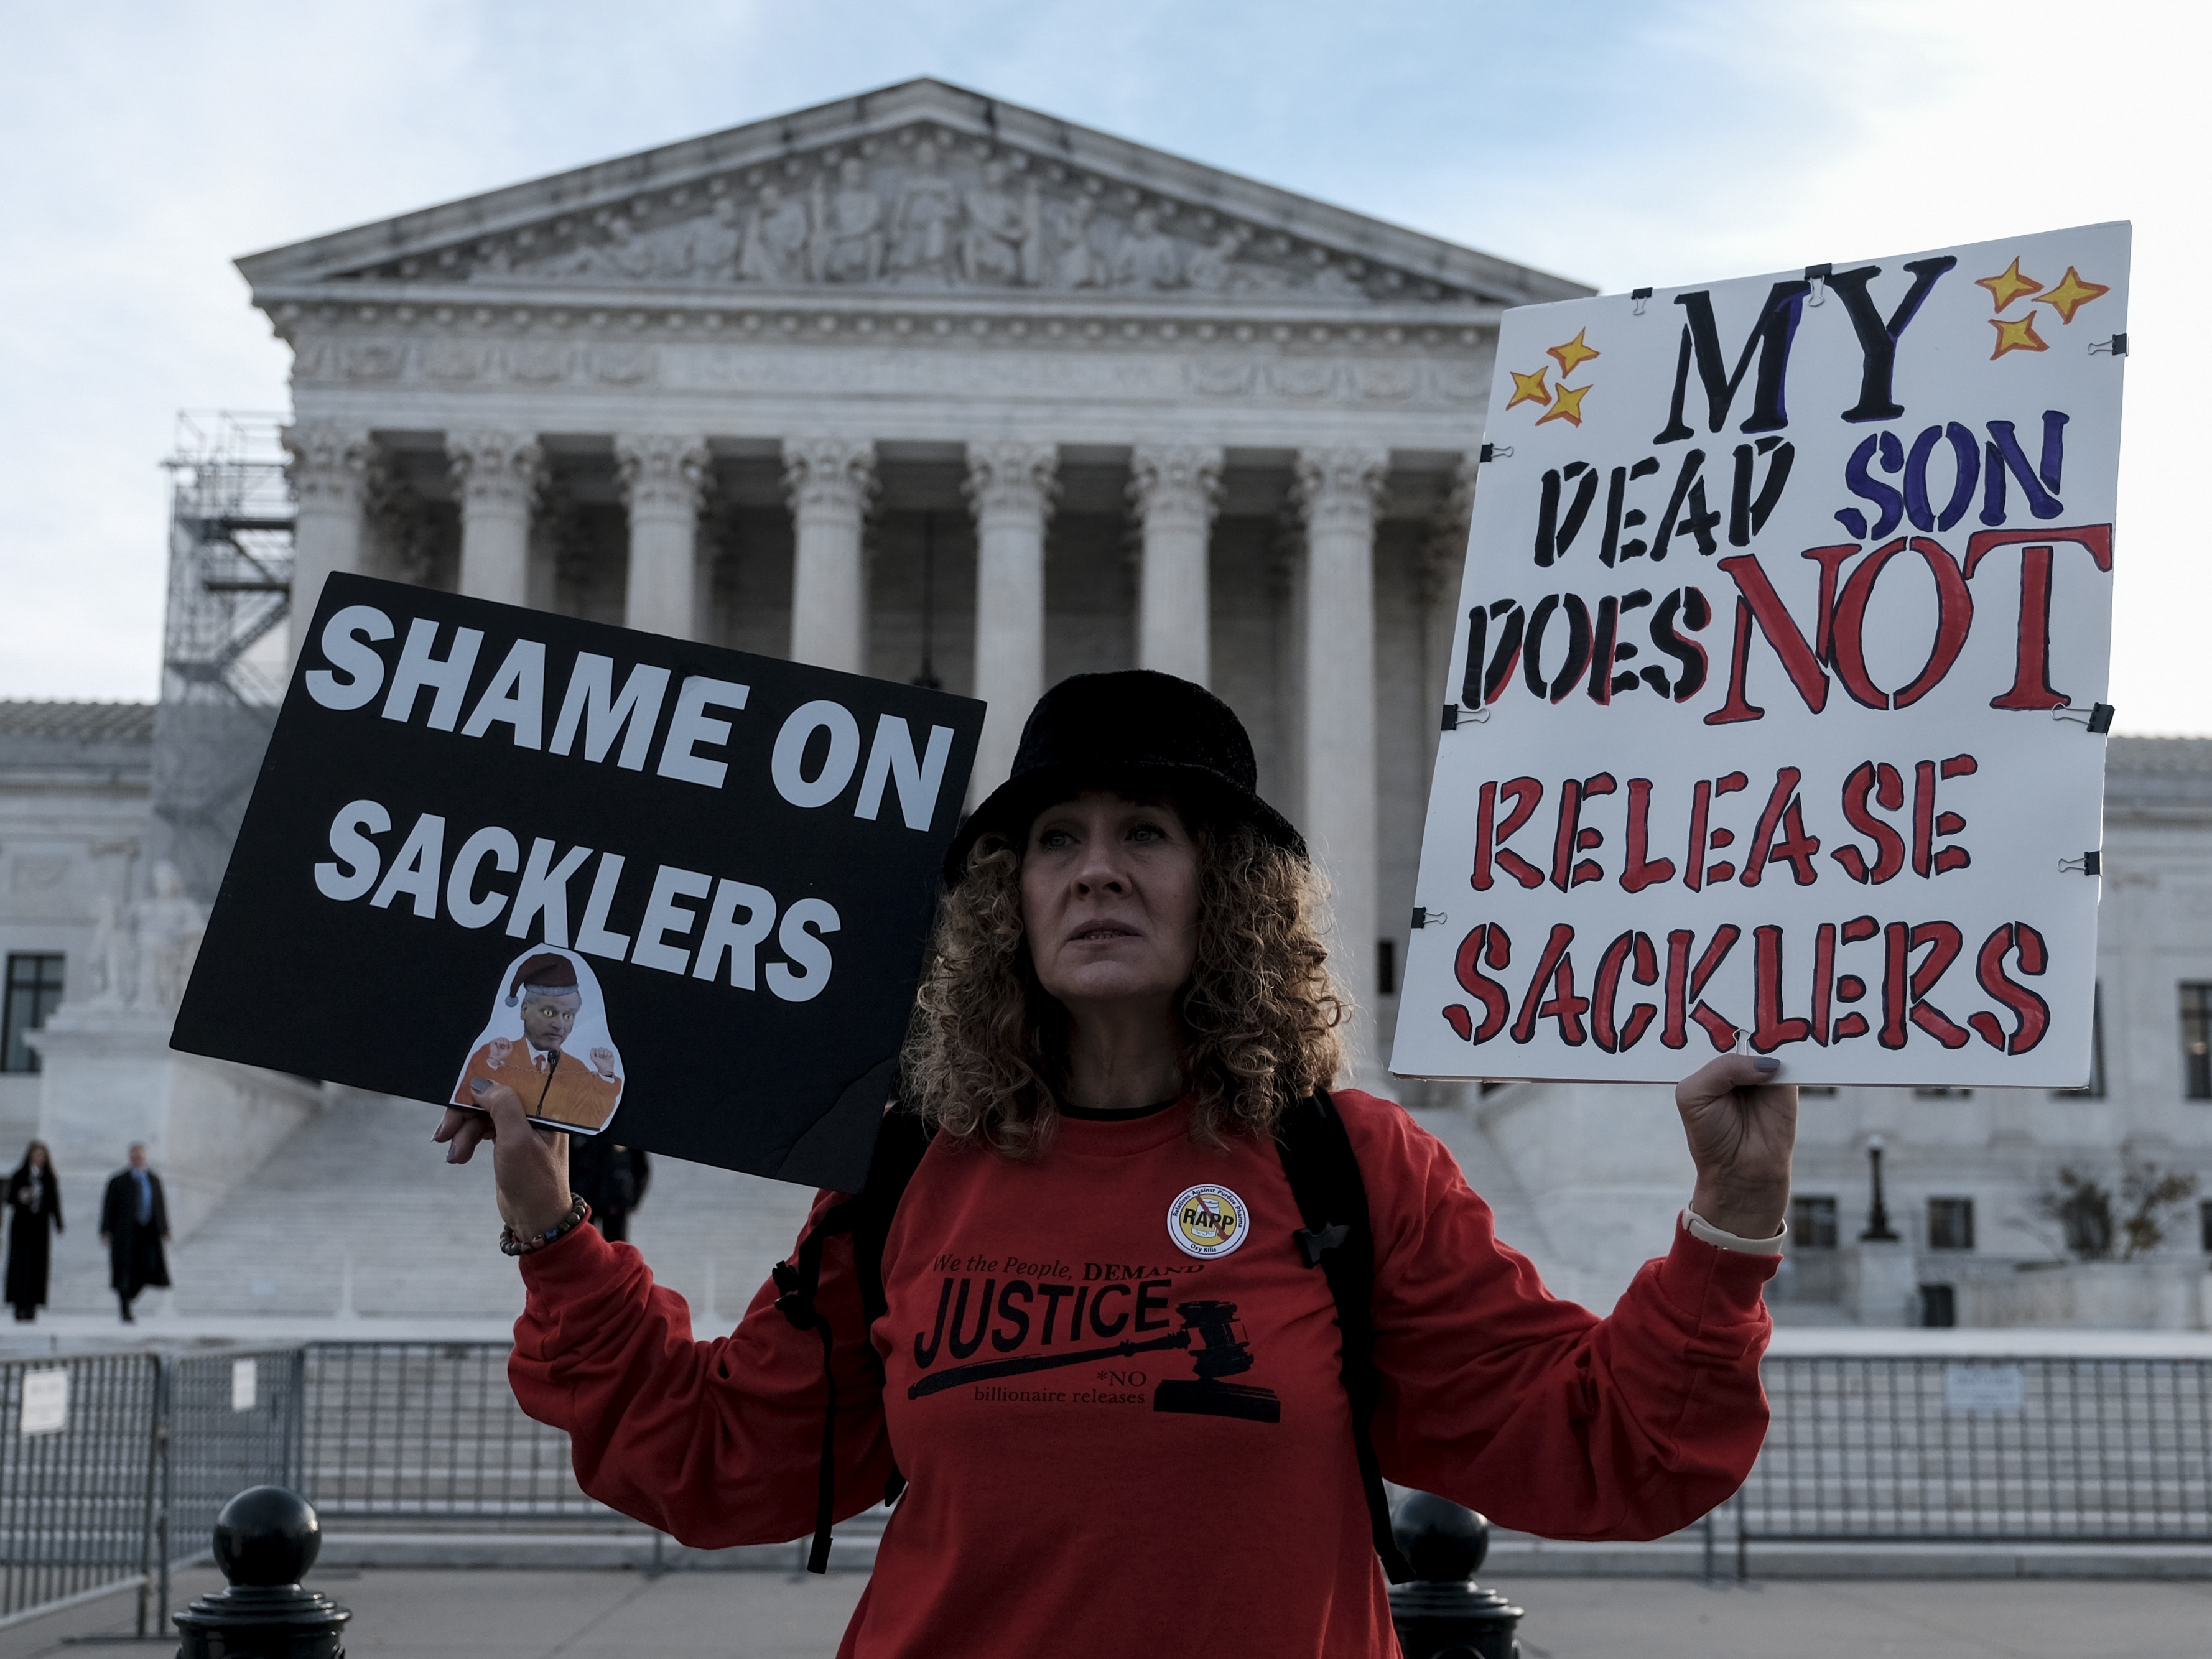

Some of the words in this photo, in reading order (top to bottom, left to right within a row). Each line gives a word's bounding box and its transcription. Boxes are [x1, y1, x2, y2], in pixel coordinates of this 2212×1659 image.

[1653, 256, 1957, 444] MY
[1534, 437, 1795, 568] DEAD
[1834, 410, 2069, 540] SON
[1462, 586, 1712, 709] DOES
[1703, 523, 2113, 726] NOT
[305, 605, 750, 788] SHAME
[771, 700, 954, 832] ON
[1471, 755, 1978, 893] RELEASE
[314, 799, 841, 1002] SACKLERS
[1442, 916, 2050, 1056] SACKLERS
[933, 1253, 962, 1272] We
[966, 1255, 998, 1272] the
[1002, 1257, 1072, 1281] People,
[1082, 1262, 1204, 1281] DEMAND
[1173, 1194, 1191, 1217] Relatives
[1217, 1189, 1237, 1205] Purdue
[1183, 1208, 1234, 1230] RAPP
[1191, 1243, 1202, 1253] Oxy
[913, 1277, 1172, 1369] JUSTICE
[974, 1387, 1066, 1403] billionaire
[1072, 1389, 1145, 1404] releases
